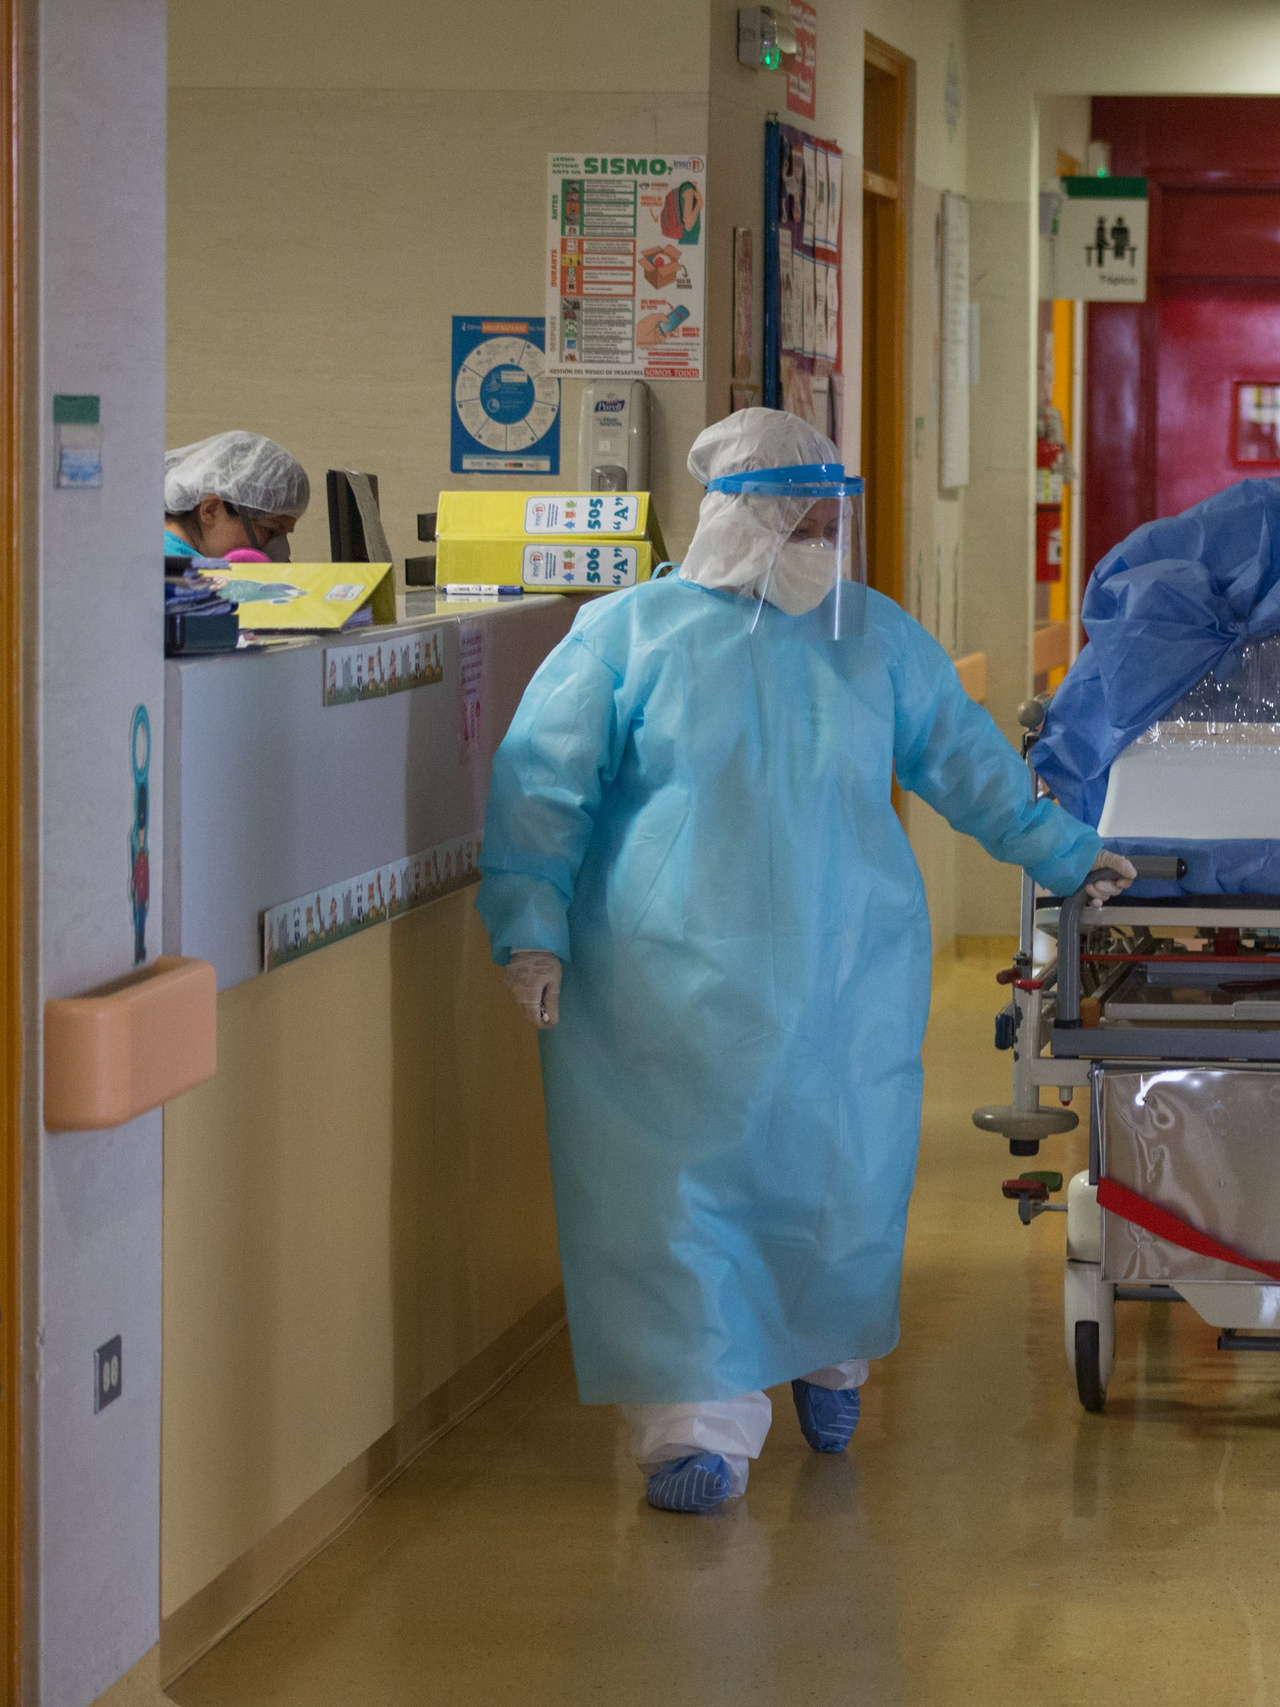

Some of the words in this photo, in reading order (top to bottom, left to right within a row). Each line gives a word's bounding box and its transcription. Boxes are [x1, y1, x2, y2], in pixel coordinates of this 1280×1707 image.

[551, 194, 559, 221] ANTES
[550, 248, 558, 287] DURANTE
[645, 368, 672, 377] SOMOS
[673, 369, 700, 377] TODOS
[587, 498, 604, 530] 505
[586, 547, 601, 584] 506
